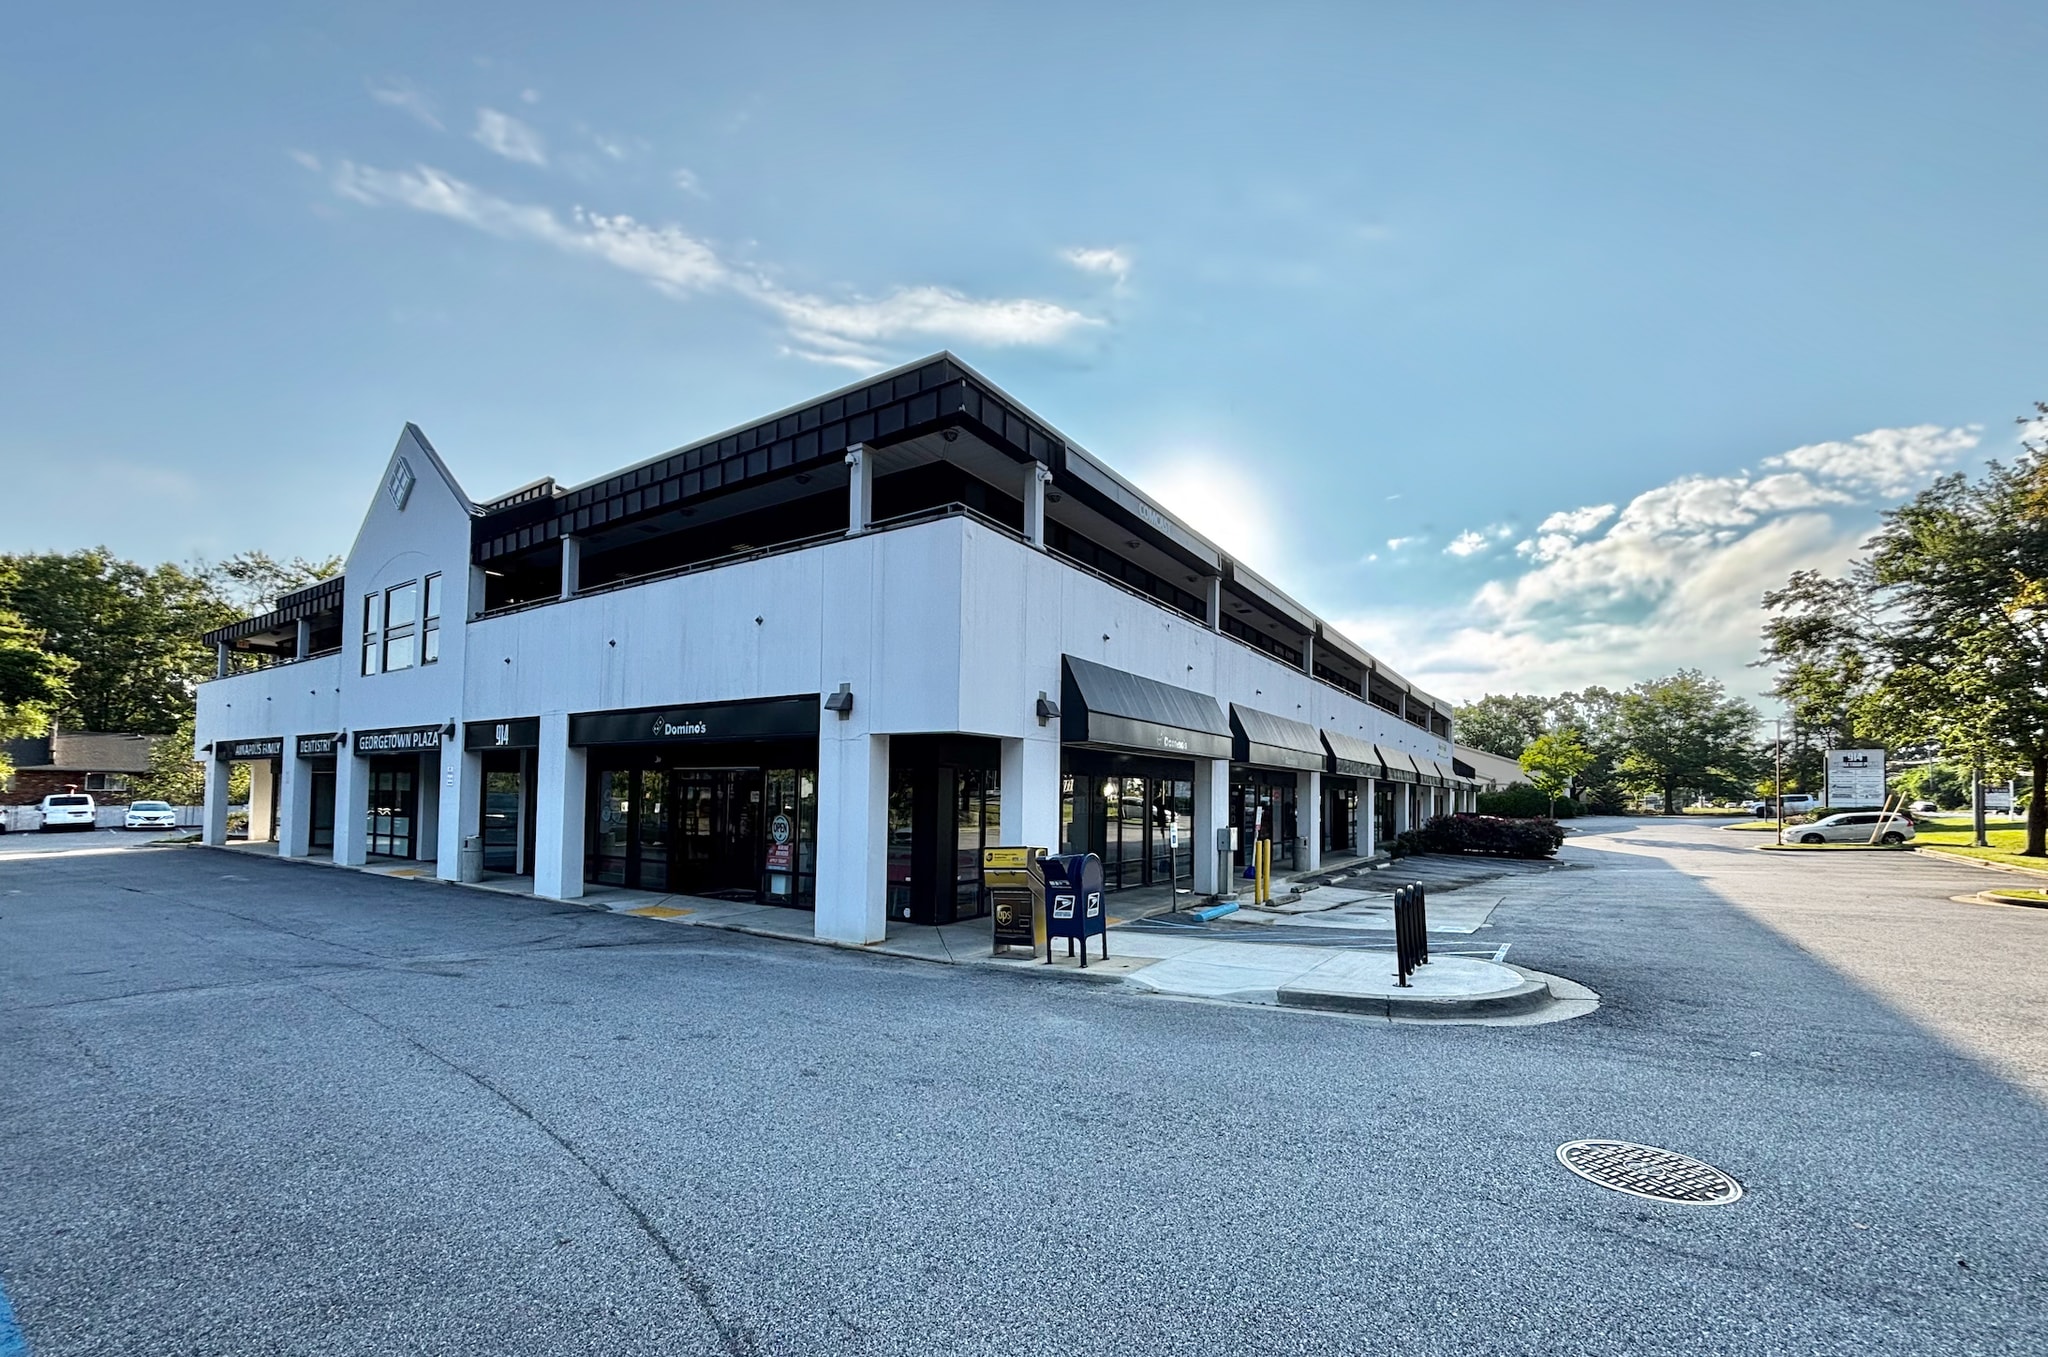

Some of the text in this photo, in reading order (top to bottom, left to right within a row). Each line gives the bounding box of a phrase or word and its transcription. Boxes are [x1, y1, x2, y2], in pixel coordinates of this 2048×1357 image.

[1138, 502, 1173, 536] COMCAST
[495, 724, 510, 746] 914
[664, 720, 707, 736] Domino's
[299, 739, 332, 753] DENTISTRY
[359, 731, 439, 750] GEORGETOWN PLAZA
[1848, 752, 1863, 762] 914
[773, 822, 788, 833] OPEN
[997, 910, 1012, 923] ups
